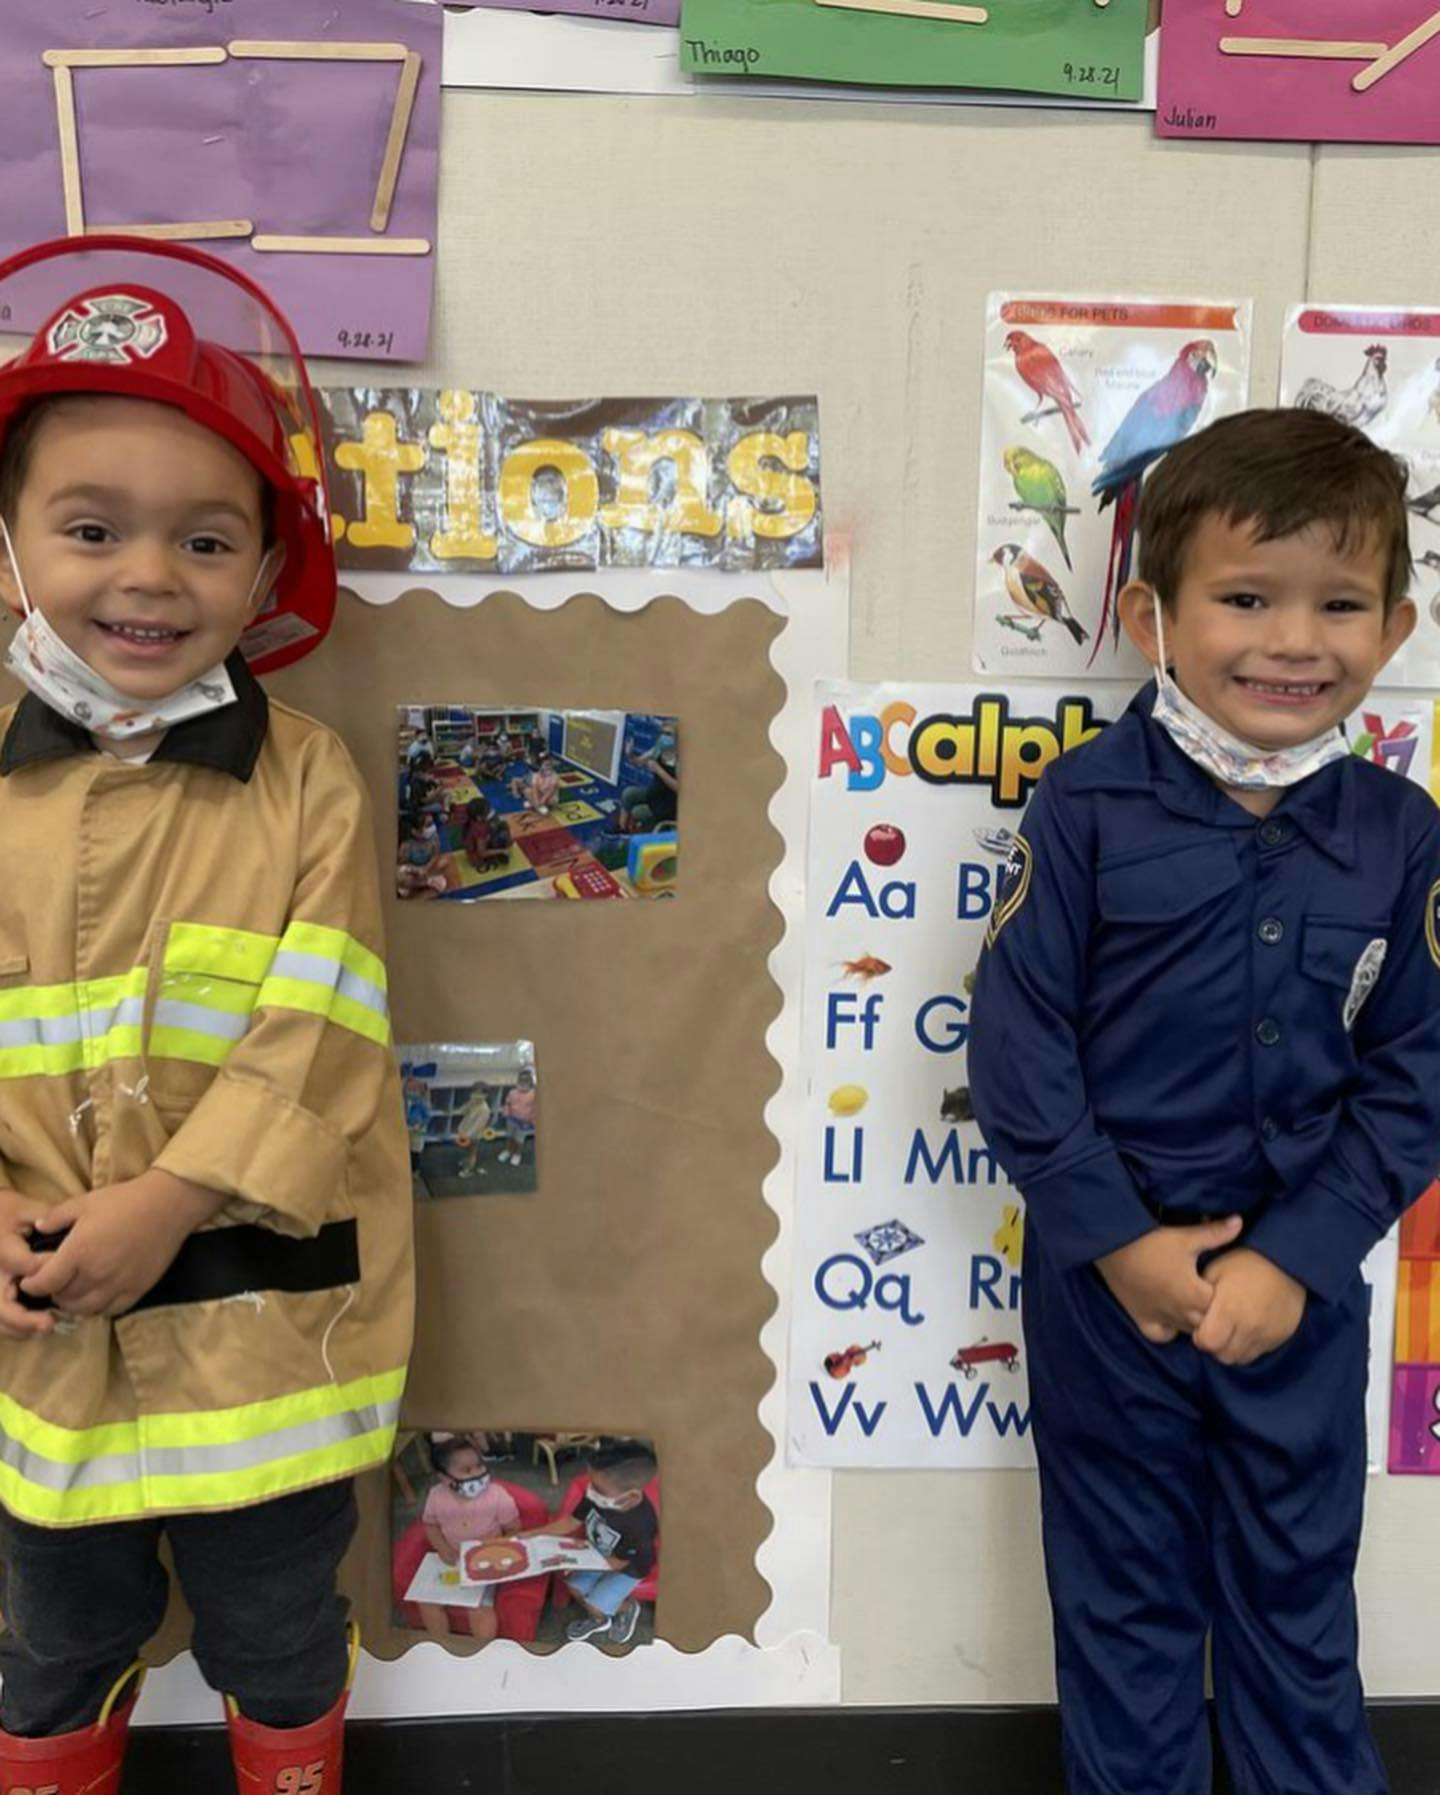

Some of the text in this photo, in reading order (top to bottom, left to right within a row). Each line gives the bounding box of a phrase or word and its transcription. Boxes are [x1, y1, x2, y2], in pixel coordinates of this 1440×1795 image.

[685, 40, 760, 72] Thiago
[1063, 63, 1120, 94] 9.28.21
[1164, 107, 1217, 129] Julian
[1060, 305, 1089, 320] FOR
[1092, 306, 1128, 321] PETS
[338, 330, 394, 354] 9.28.21
[817, 701, 918, 792] ABC
[826, 860, 1005, 920] Aa B
[826, 992, 885, 1050] Ff
[823, 1126, 864, 1183] Ll
[814, 1253, 925, 1326] Qq
[809, 1381, 1031, 1437] Vv Ww
